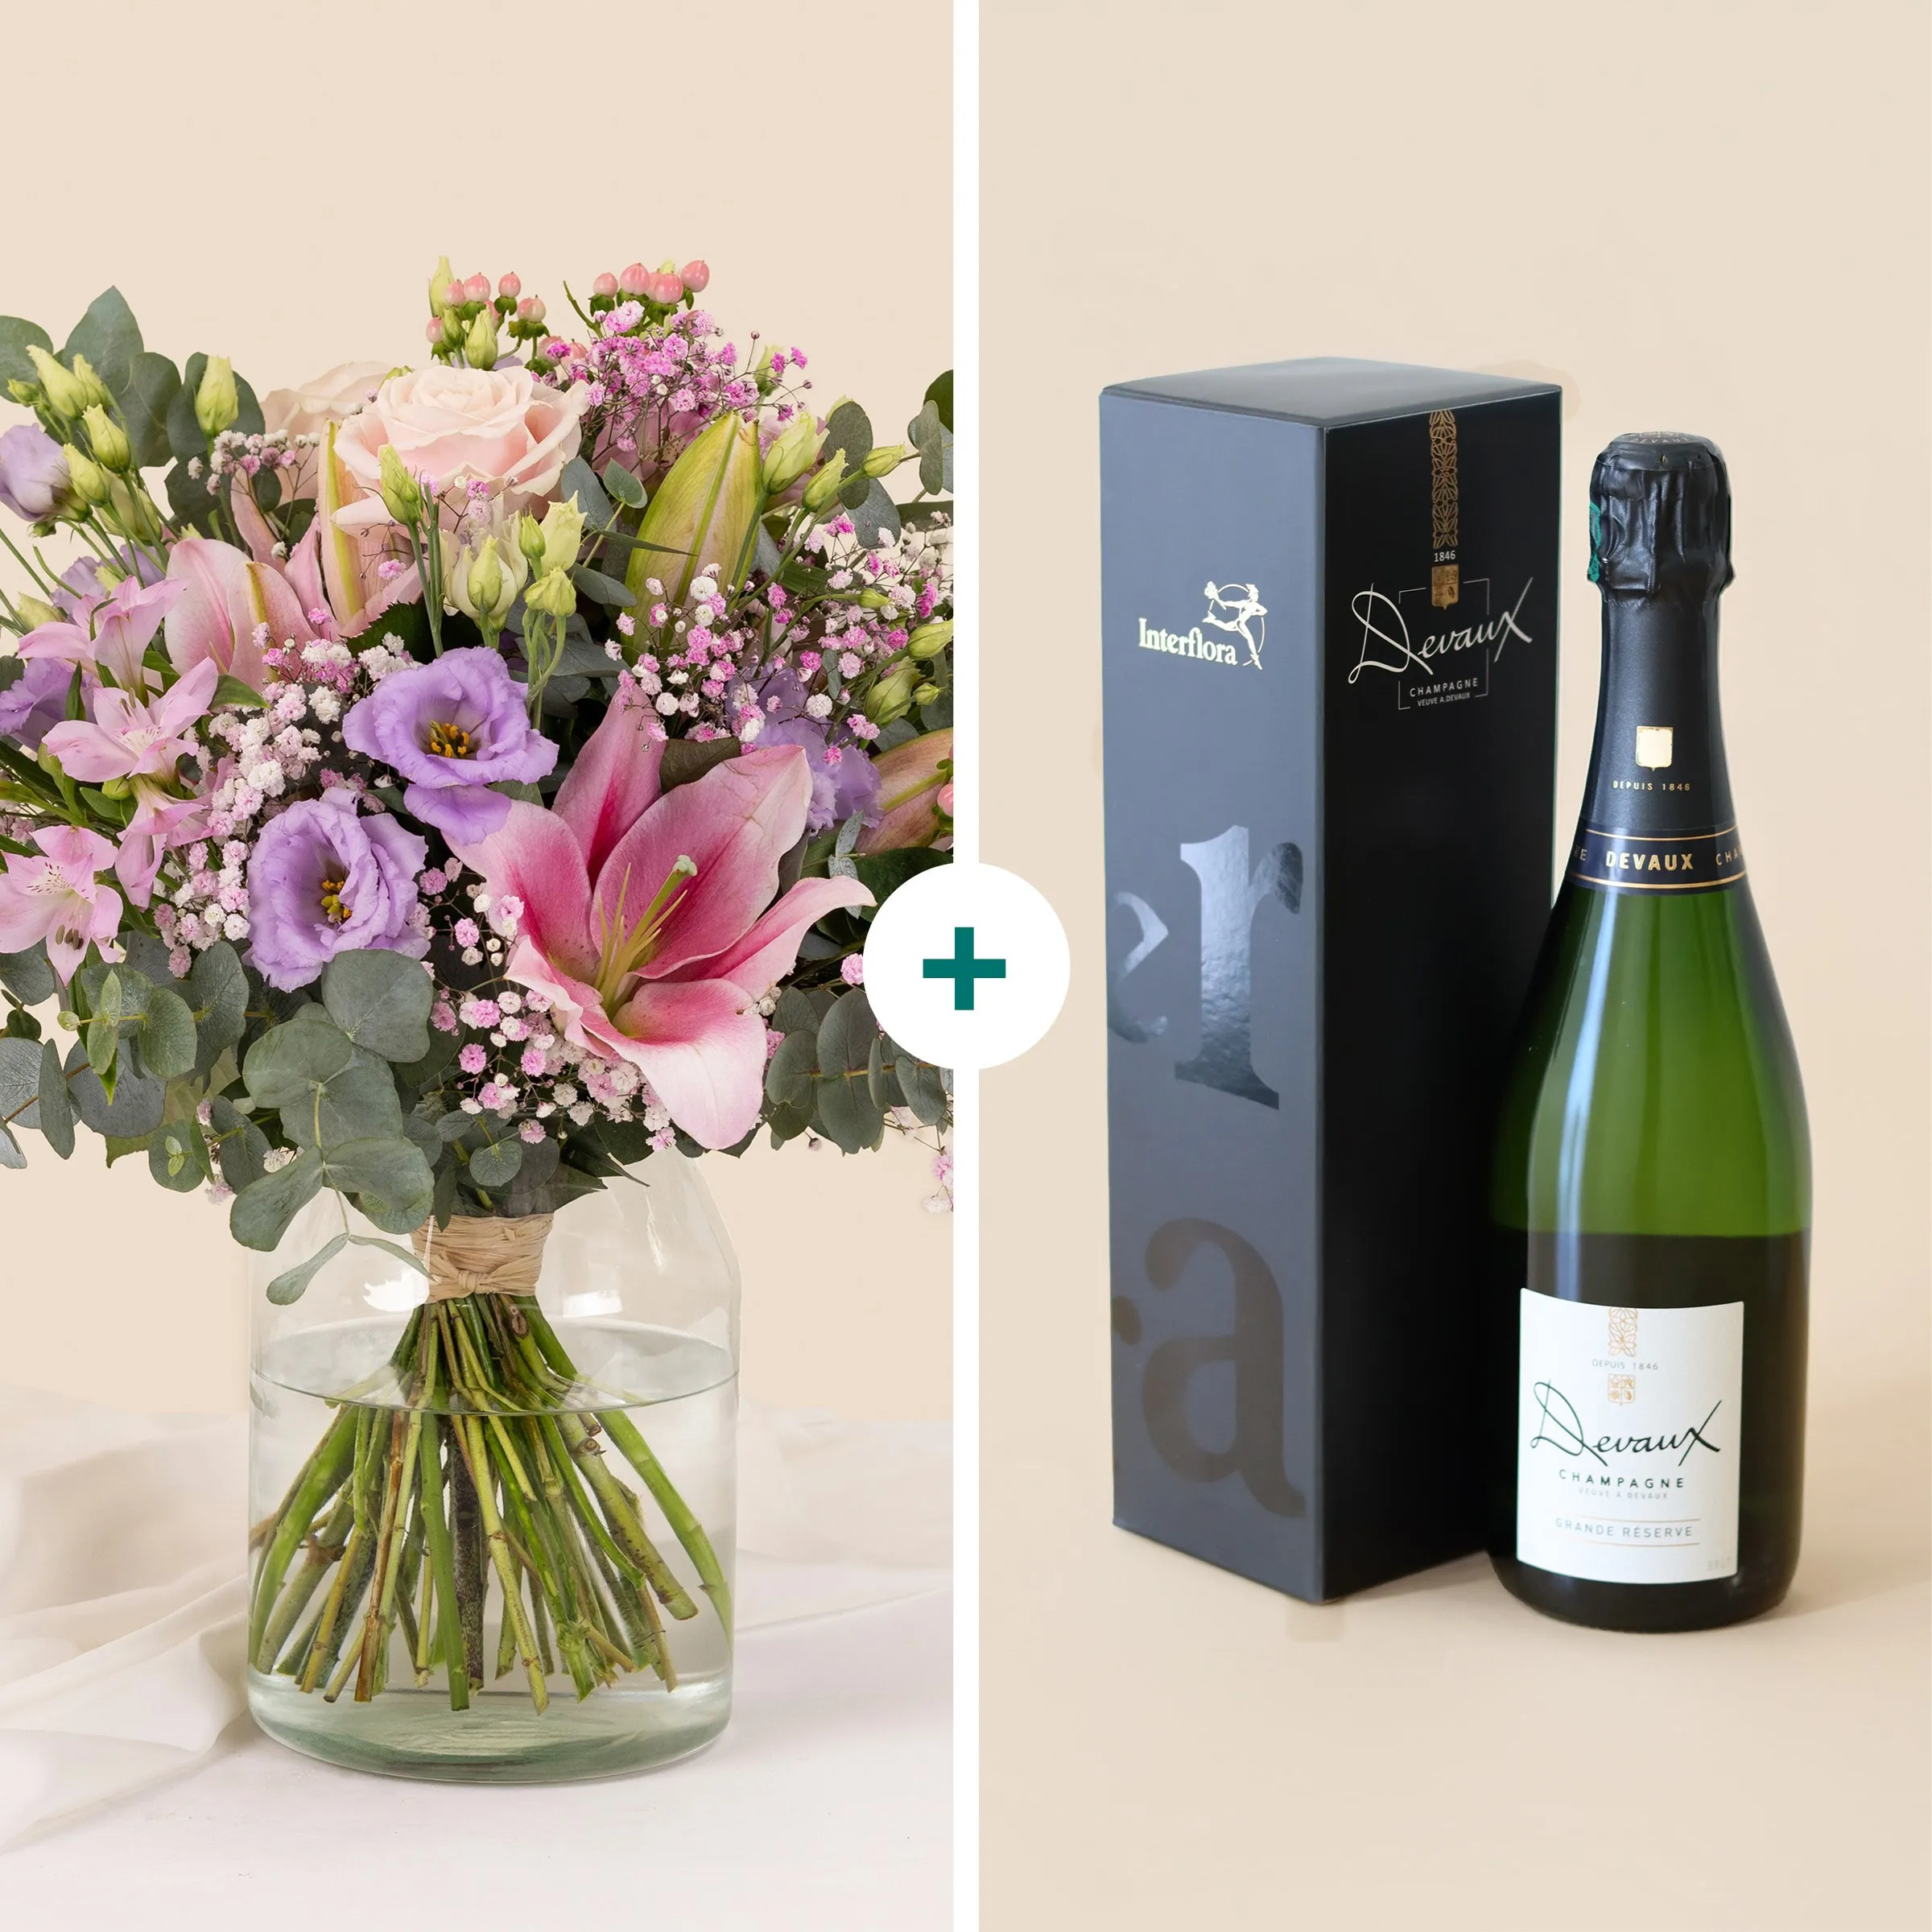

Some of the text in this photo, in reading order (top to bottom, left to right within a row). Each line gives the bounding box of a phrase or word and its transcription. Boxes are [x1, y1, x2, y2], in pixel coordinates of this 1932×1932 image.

[1434, 550, 1456, 563] 1846
[1348, 577, 1534, 685] Devaux
[1137, 617, 1238, 666] Interflora
[1409, 677, 1479, 697] CHAMPAGNE
[1417, 696, 1439, 708] VEUVE
[1612, 779, 1691, 792] DEPUIS 1846
[1605, 850, 1694, 871] DEVAUX
[1591, 1358, 1659, 1370] DEPUIS 1846
[1530, 1379, 1723, 1467] Devaux
[1558, 1469, 1685, 1488] CHAMPAGNE
[1579, 1488, 1610, 1497] VEUVE
[1627, 1491, 1668, 1500] DEVAUX
[1555, 1517, 1693, 1538] GRANDE RÉSERVE
